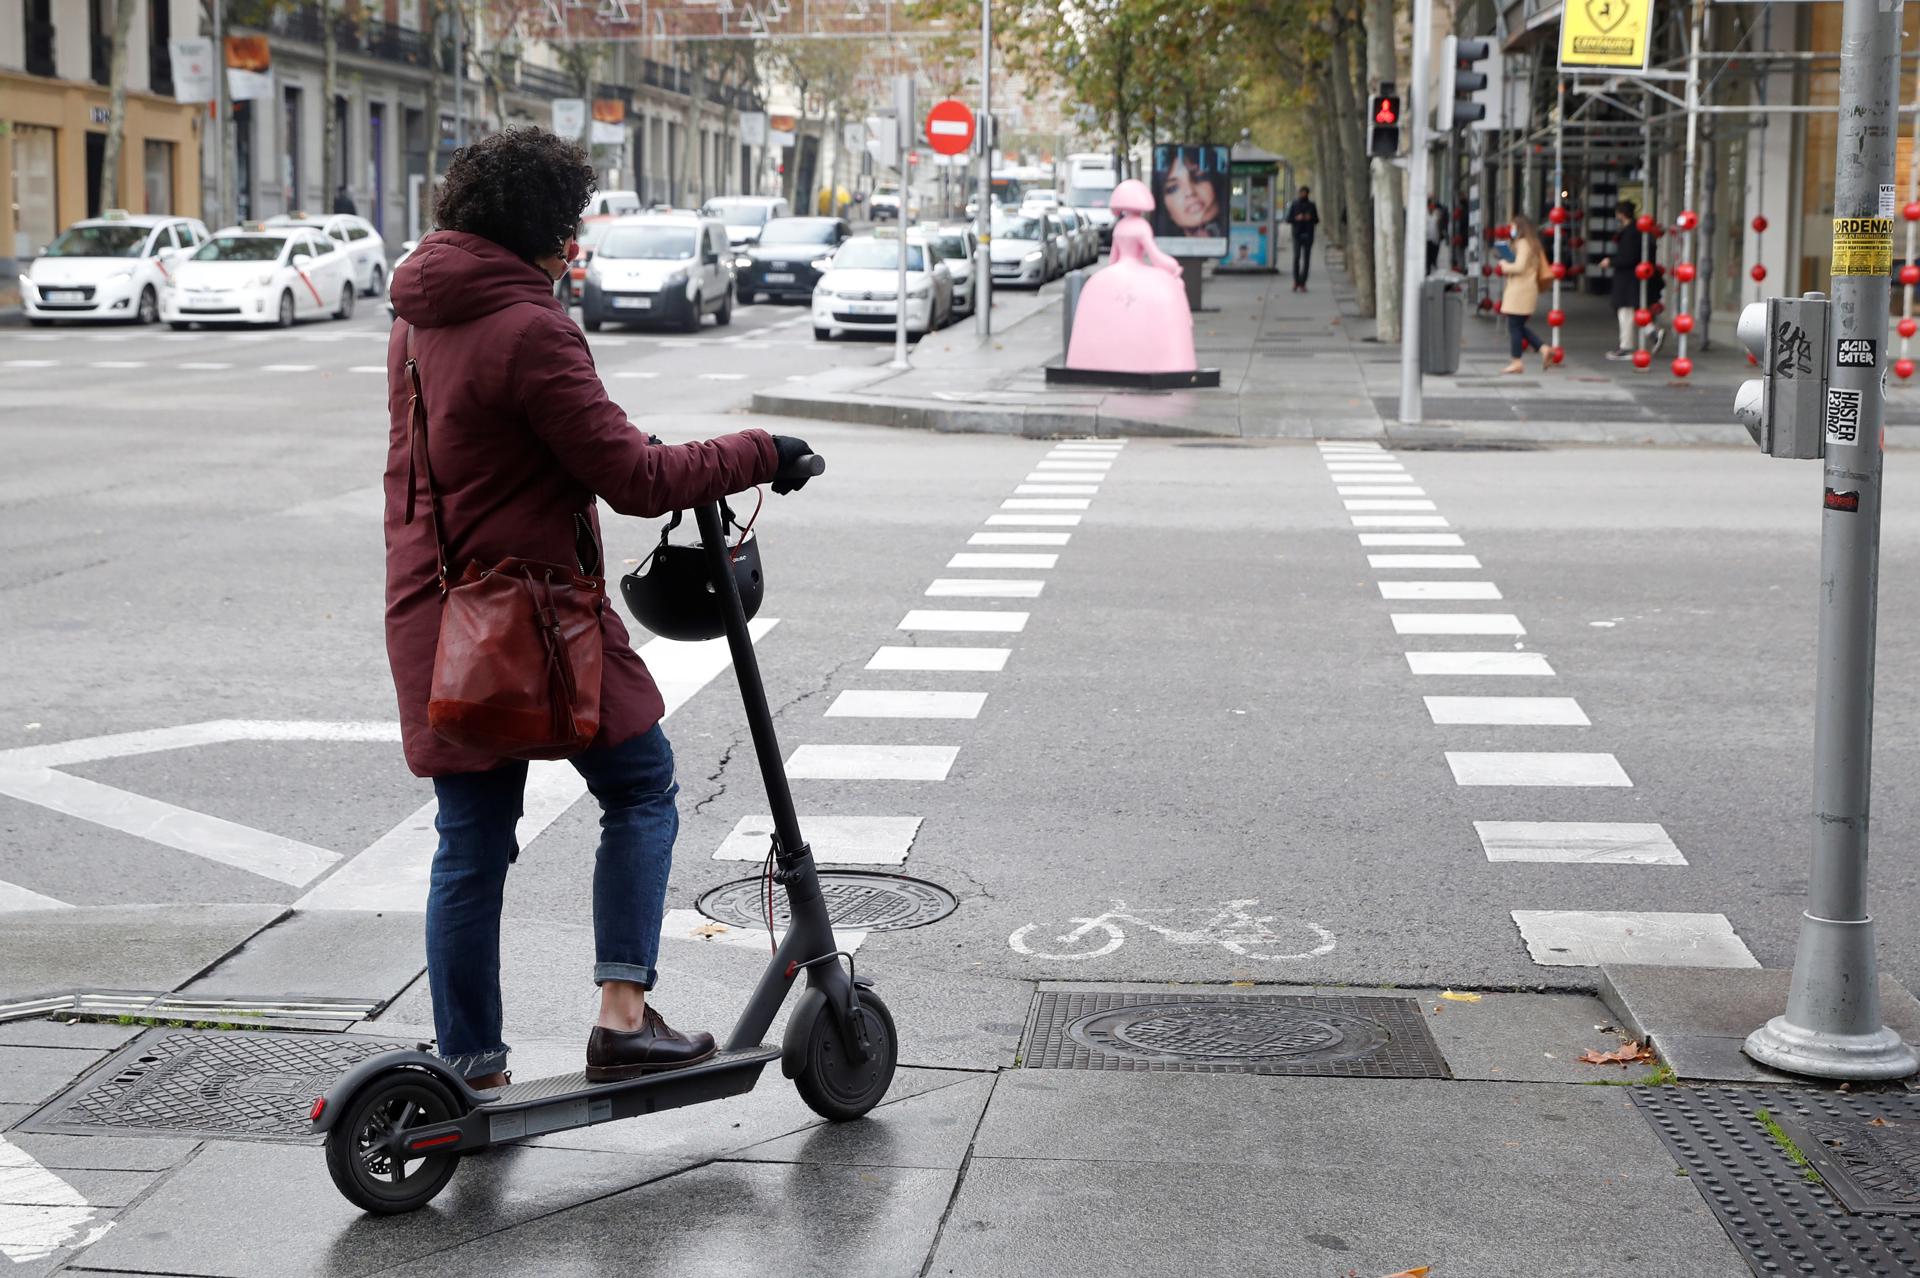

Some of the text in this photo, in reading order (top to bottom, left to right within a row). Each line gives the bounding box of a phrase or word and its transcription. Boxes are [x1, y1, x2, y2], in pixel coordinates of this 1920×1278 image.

[1840, 340, 1871, 352] ACID
[1838, 352, 1874, 365] EATER
[1838, 391, 1860, 442] HASTER
